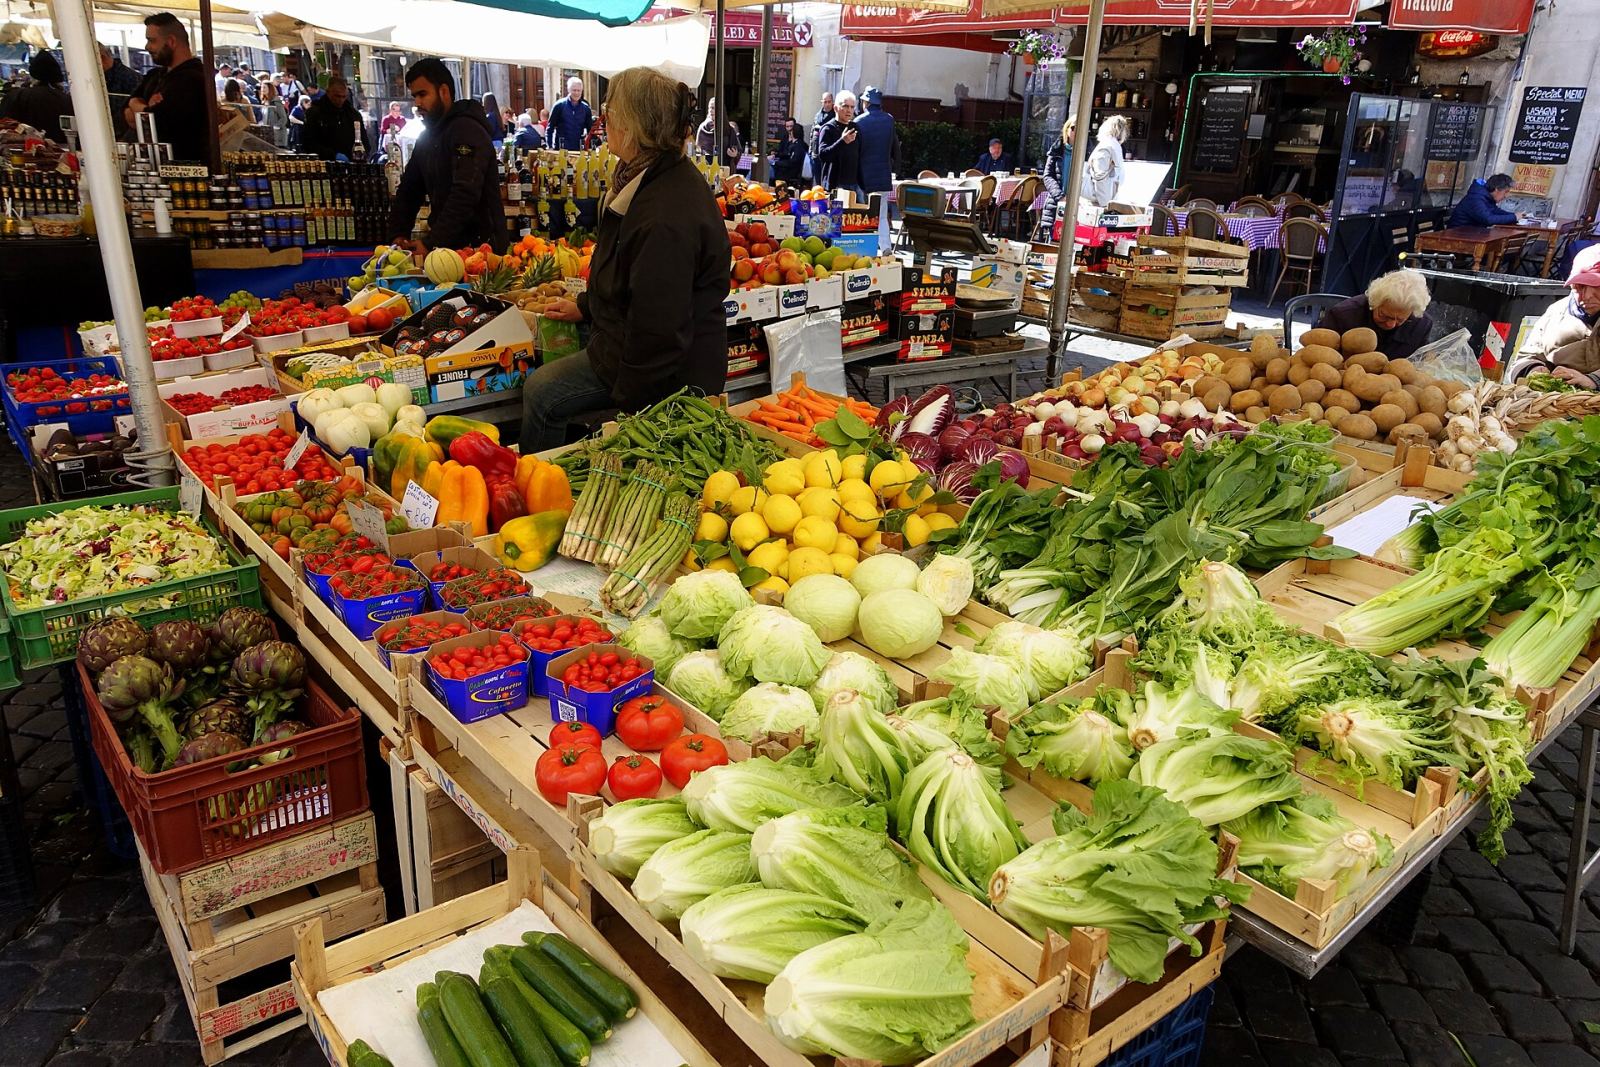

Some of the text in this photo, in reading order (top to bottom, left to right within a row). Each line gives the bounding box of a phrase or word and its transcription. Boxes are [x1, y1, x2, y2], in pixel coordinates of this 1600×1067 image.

[748, 27, 757, 39] &
[1525, 86, 1585, 101] Special MENU
[1526, 106, 1557, 116] LASAGNA
[1524, 115, 1556, 124] POLENTA
[848, 278, 870, 290] Melinda
[911, 287, 949, 297] SIMBA
[782, 293, 807, 305] Melinda
[841, 314, 881, 330] SIMBA
[909, 334, 945, 344] SIMBA
[470, 352, 497, 363] MANGO
[437, 369, 468, 383] FRUNET
[488, 681, 522, 696] Cofanetto
